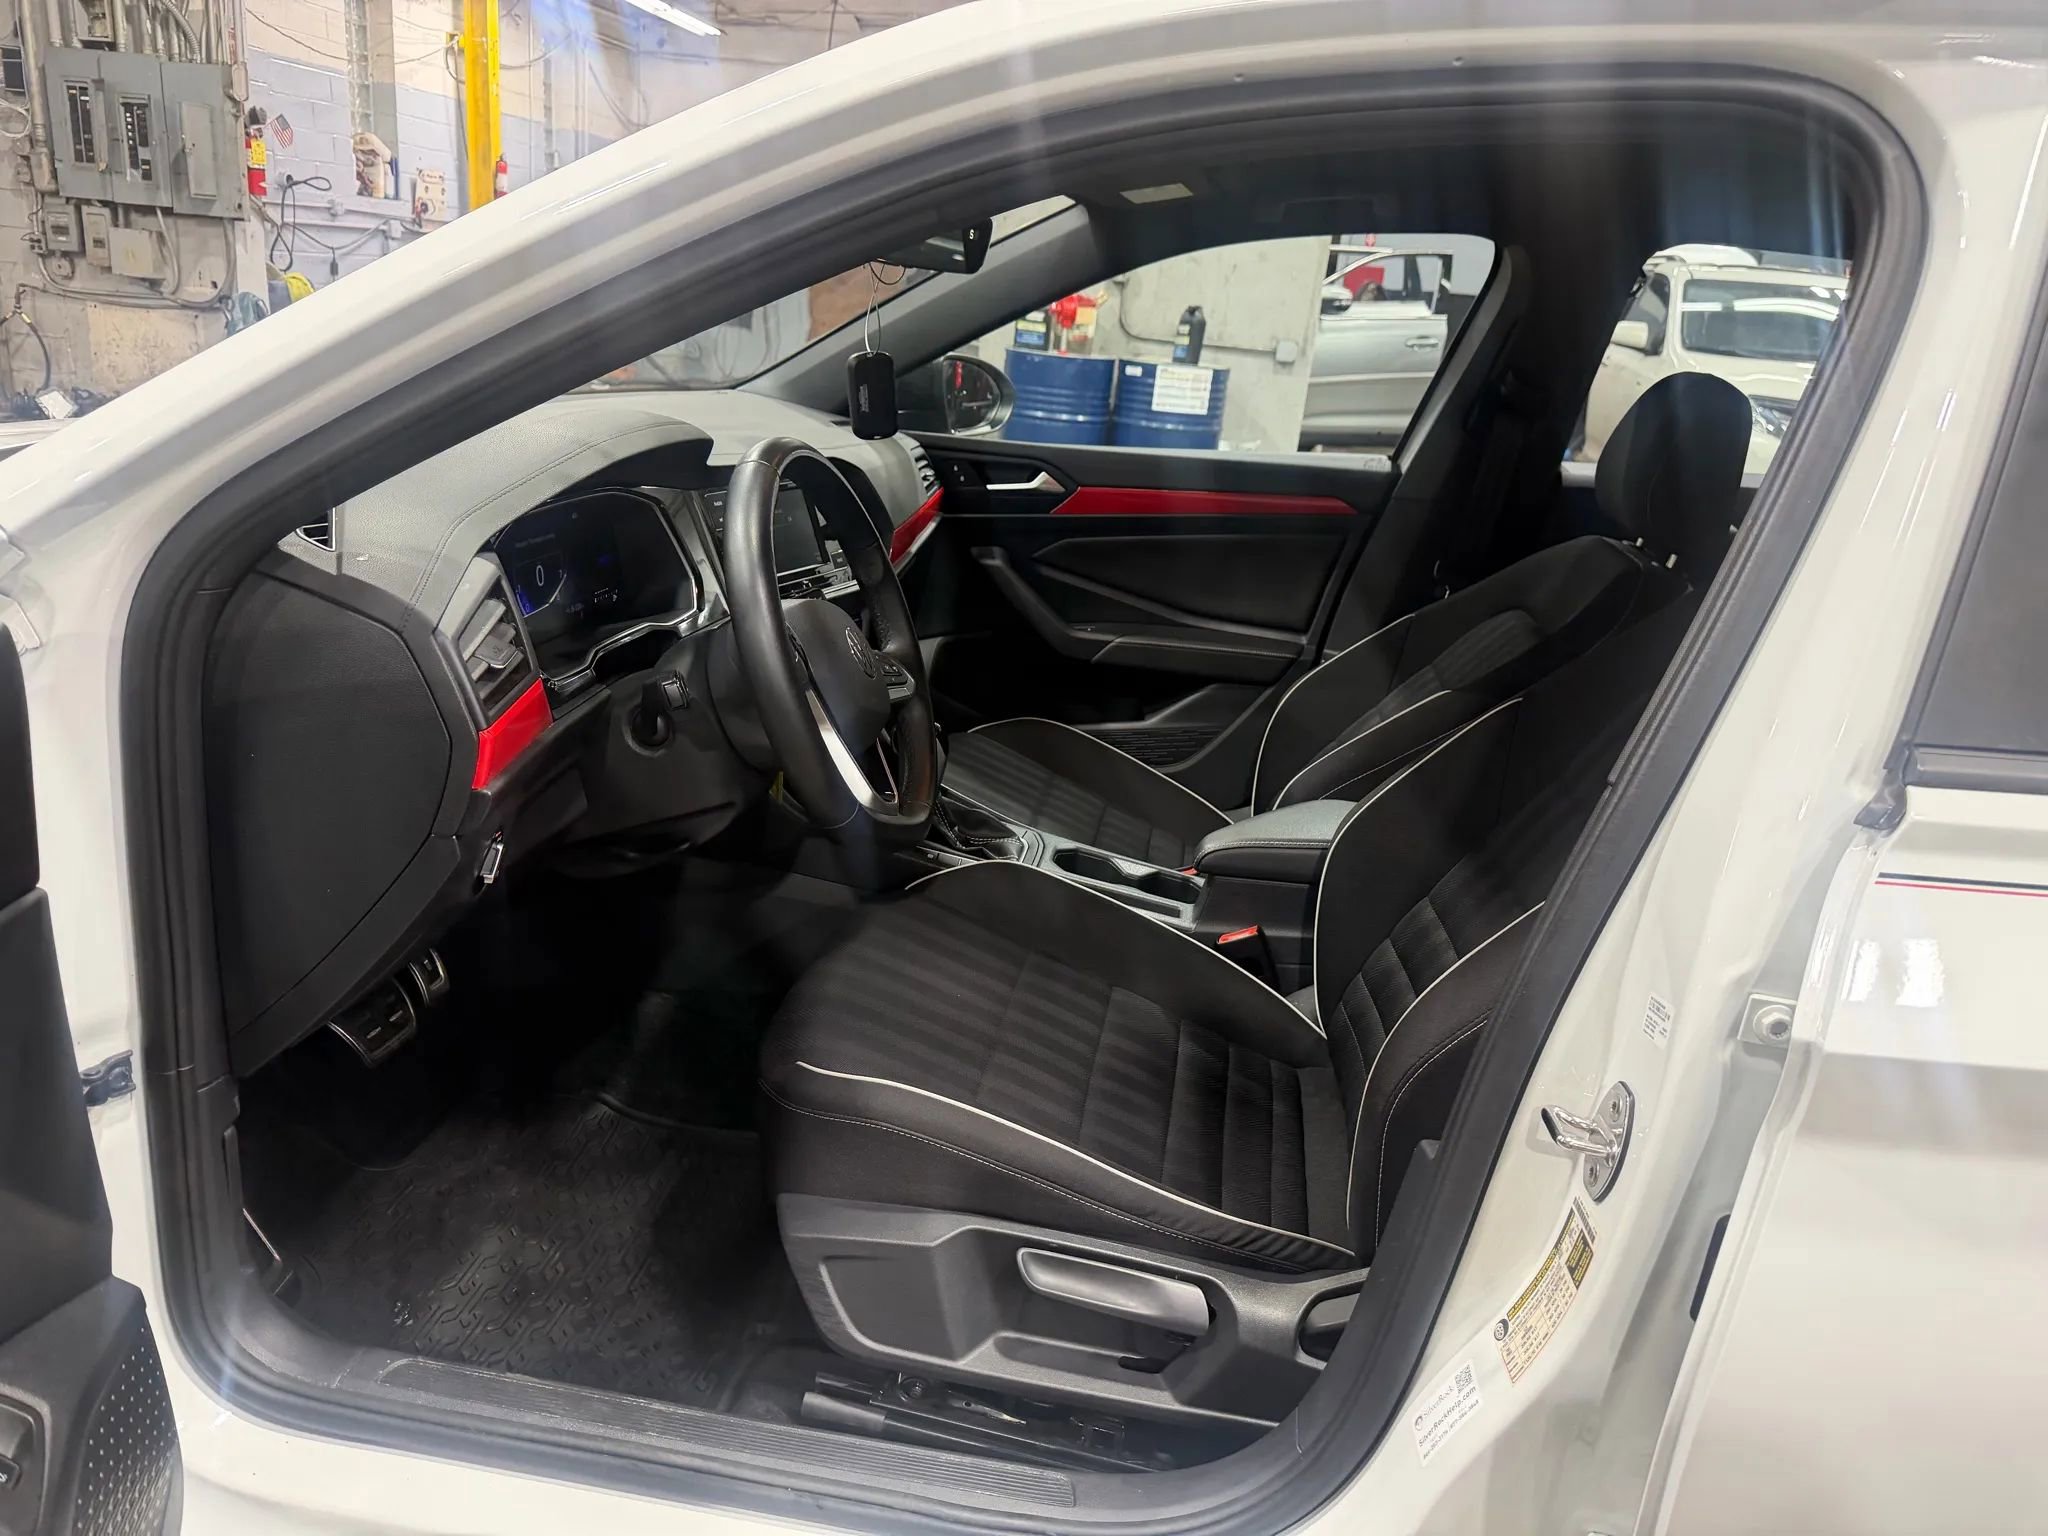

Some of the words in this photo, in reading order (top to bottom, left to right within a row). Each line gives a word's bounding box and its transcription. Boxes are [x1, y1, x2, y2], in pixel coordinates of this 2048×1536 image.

[969, 228, 975, 240] S
[536, 565, 544, 586] 0
[1419, 1386, 1476, 1447] SilverRockHelp.com
